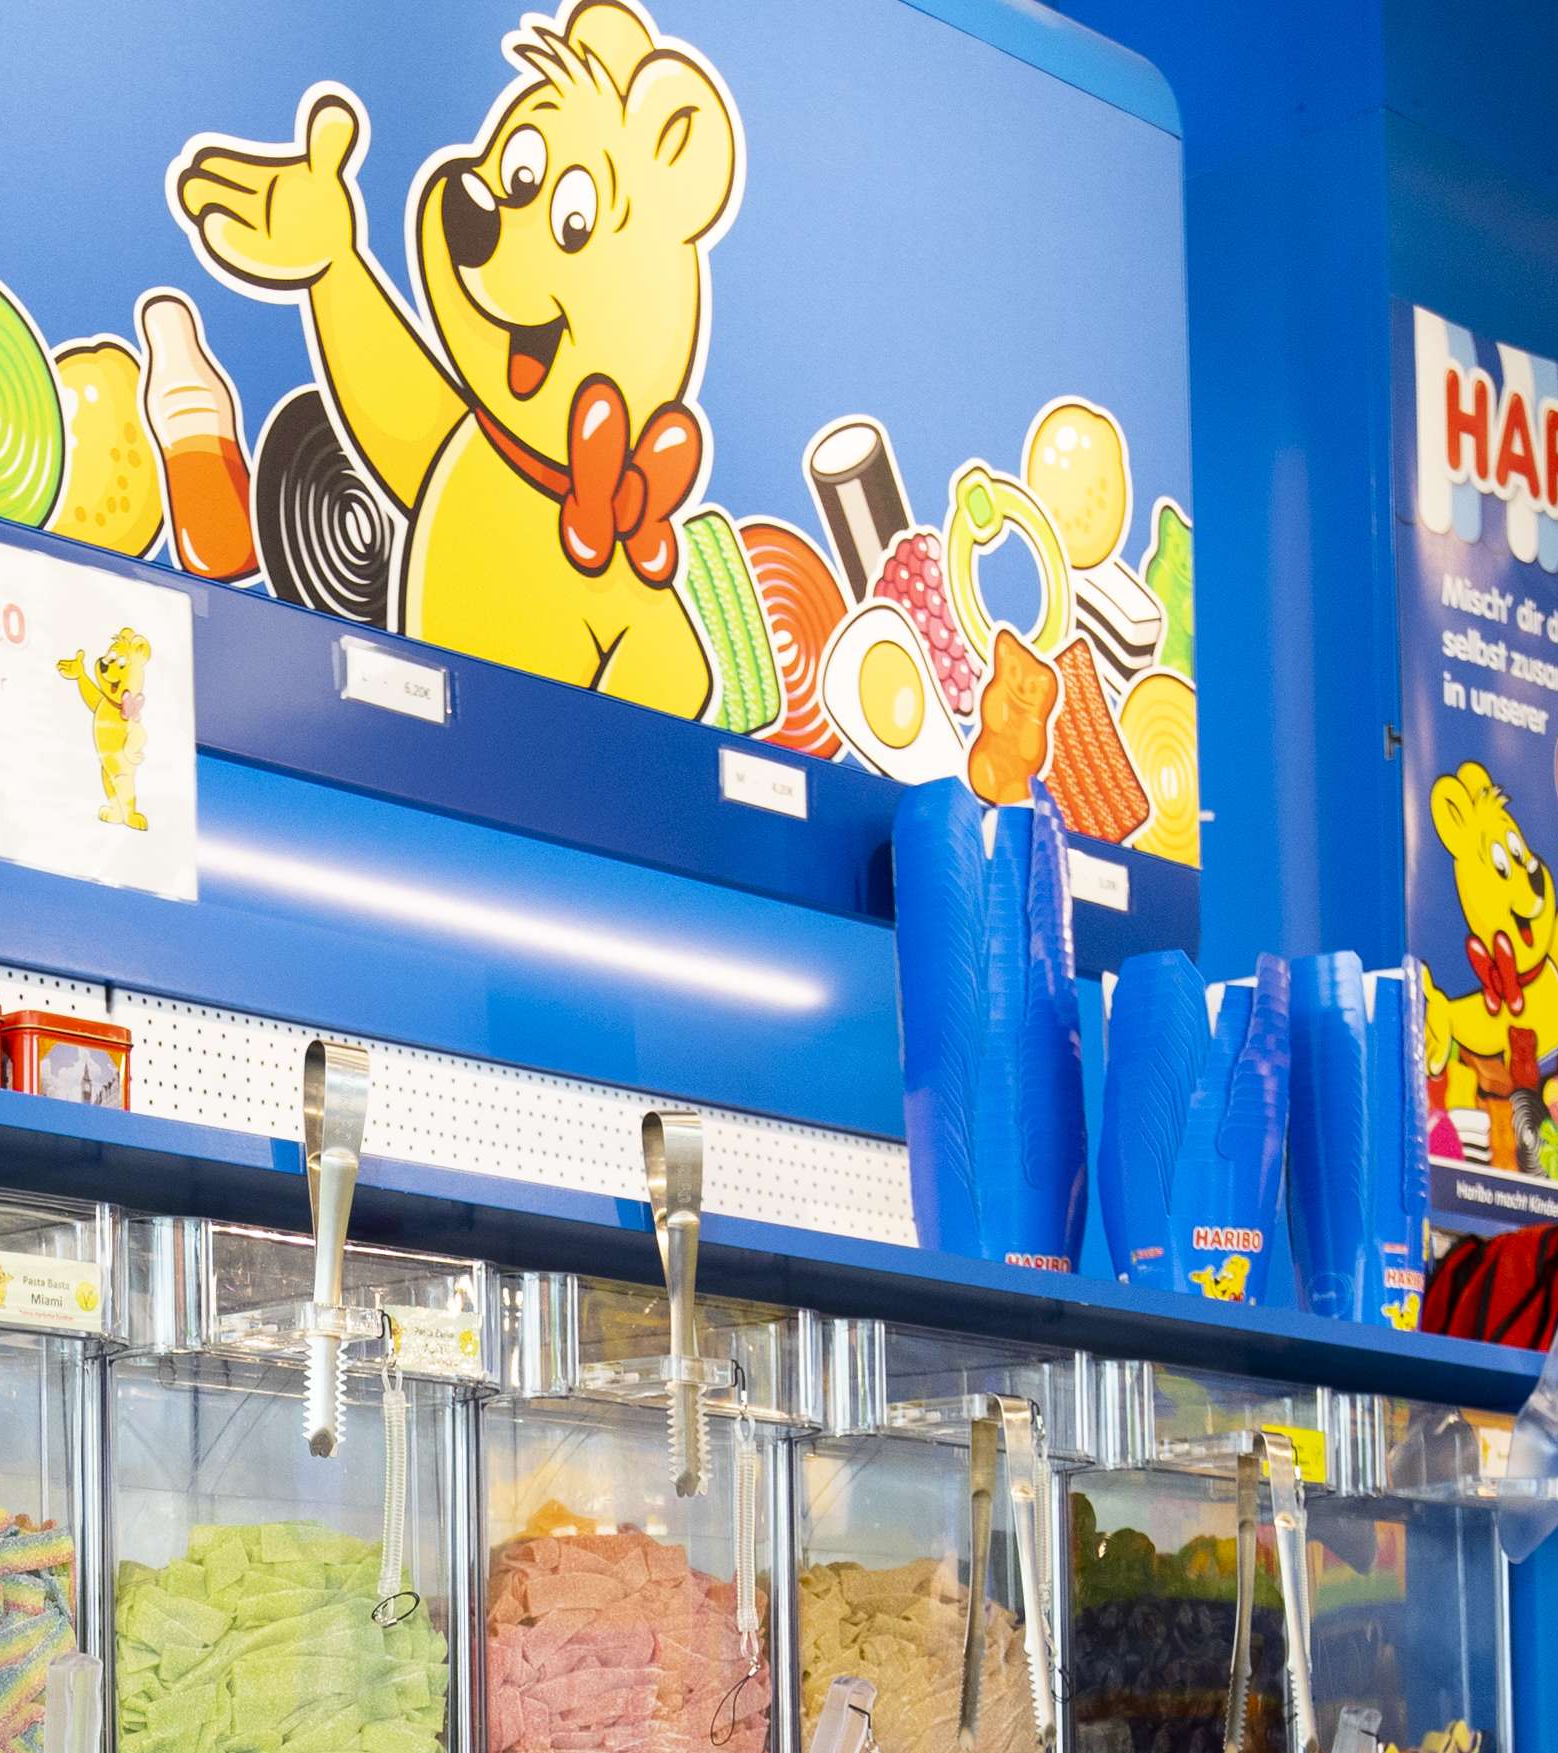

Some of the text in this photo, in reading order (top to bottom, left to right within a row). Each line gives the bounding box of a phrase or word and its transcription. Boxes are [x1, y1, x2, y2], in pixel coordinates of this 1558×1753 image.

[1516, 596, 1544, 636] dir
[1441, 629, 1507, 675] selbst
[1442, 673, 1548, 735] in unserer
[1456, 1179, 1494, 1206] Haribo
[1193, 1228, 1264, 1253] HARIBO
[22, 1275, 46, 1288] Pasta
[31, 1293, 63, 1308] Miami
